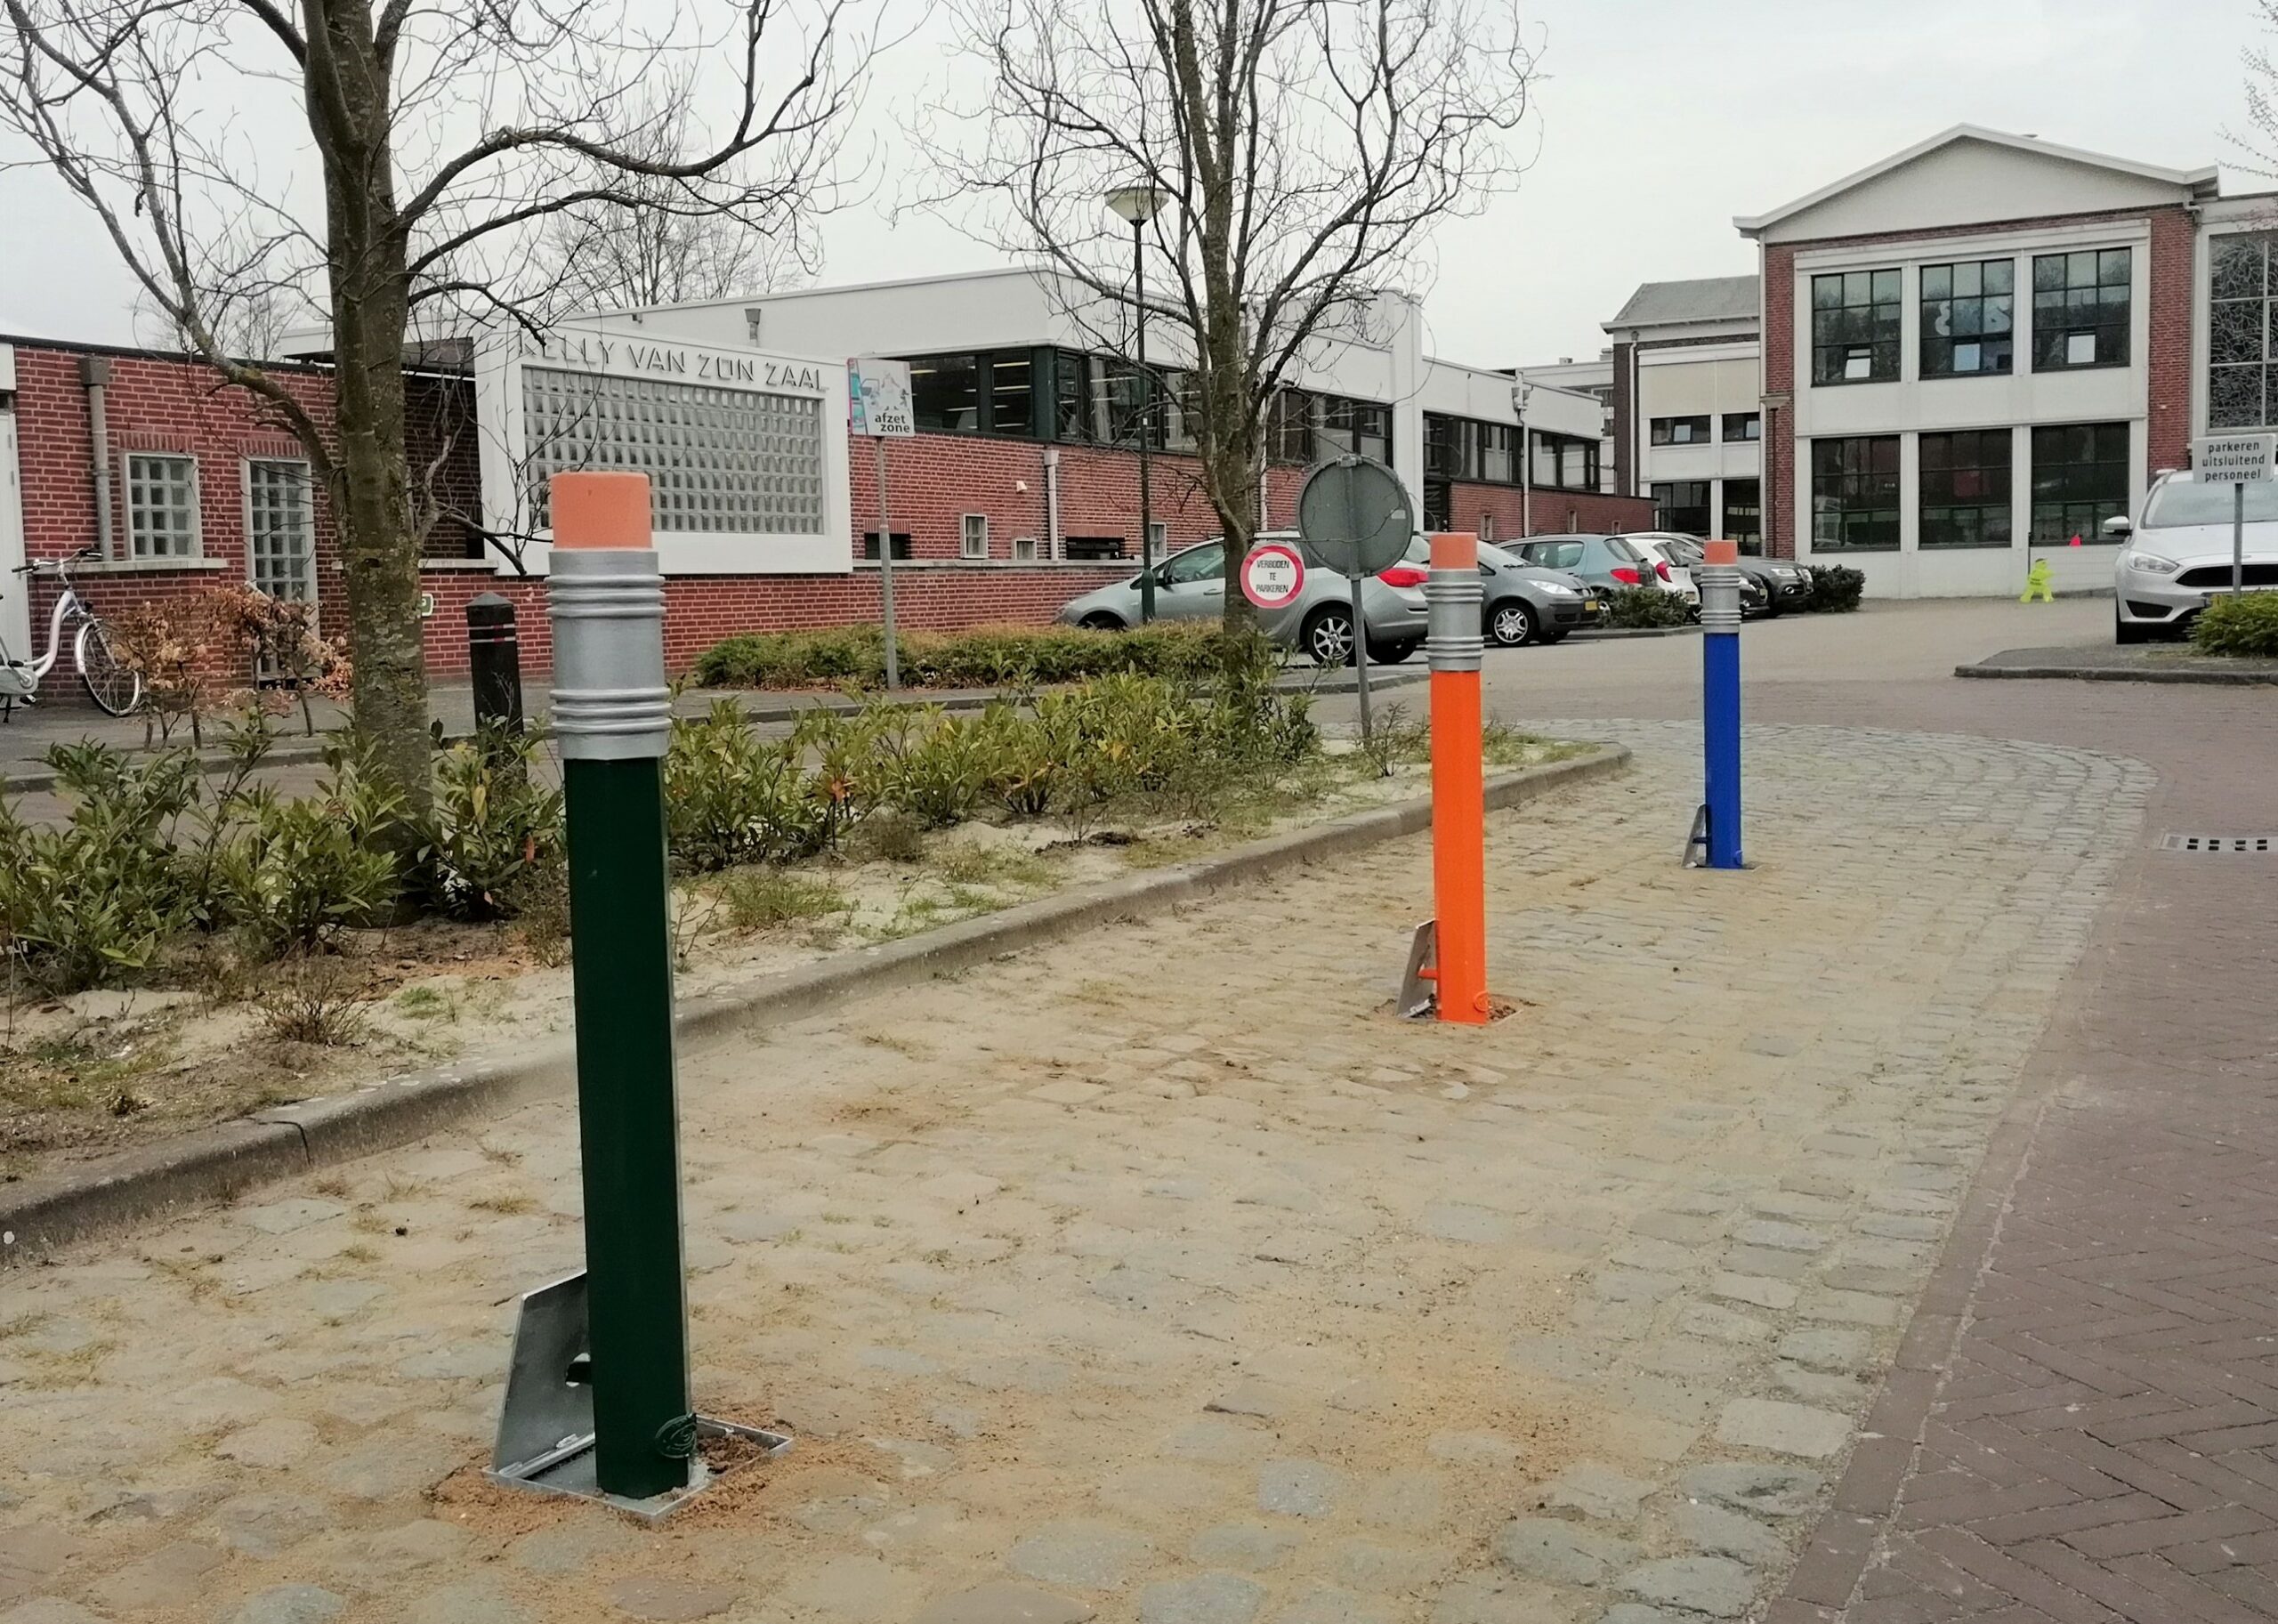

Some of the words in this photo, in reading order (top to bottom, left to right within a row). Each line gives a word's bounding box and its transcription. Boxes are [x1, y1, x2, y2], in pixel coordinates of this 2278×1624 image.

[627, 343, 685, 374] VAN
[698, 353, 754, 382] ZON
[765, 362, 828, 392] ZAAL
[875, 412, 905, 424] afzet
[880, 424, 910, 433] zone
[2209, 441, 2259, 455] parkeren
[2202, 454, 2265, 467] uitsluitend
[2205, 469, 2261, 483] personeel
[1256, 560, 1290, 569] VERBODEN
[1269, 572, 1277, 581] TE
[1256, 584, 1289, 594] PARKEREN
